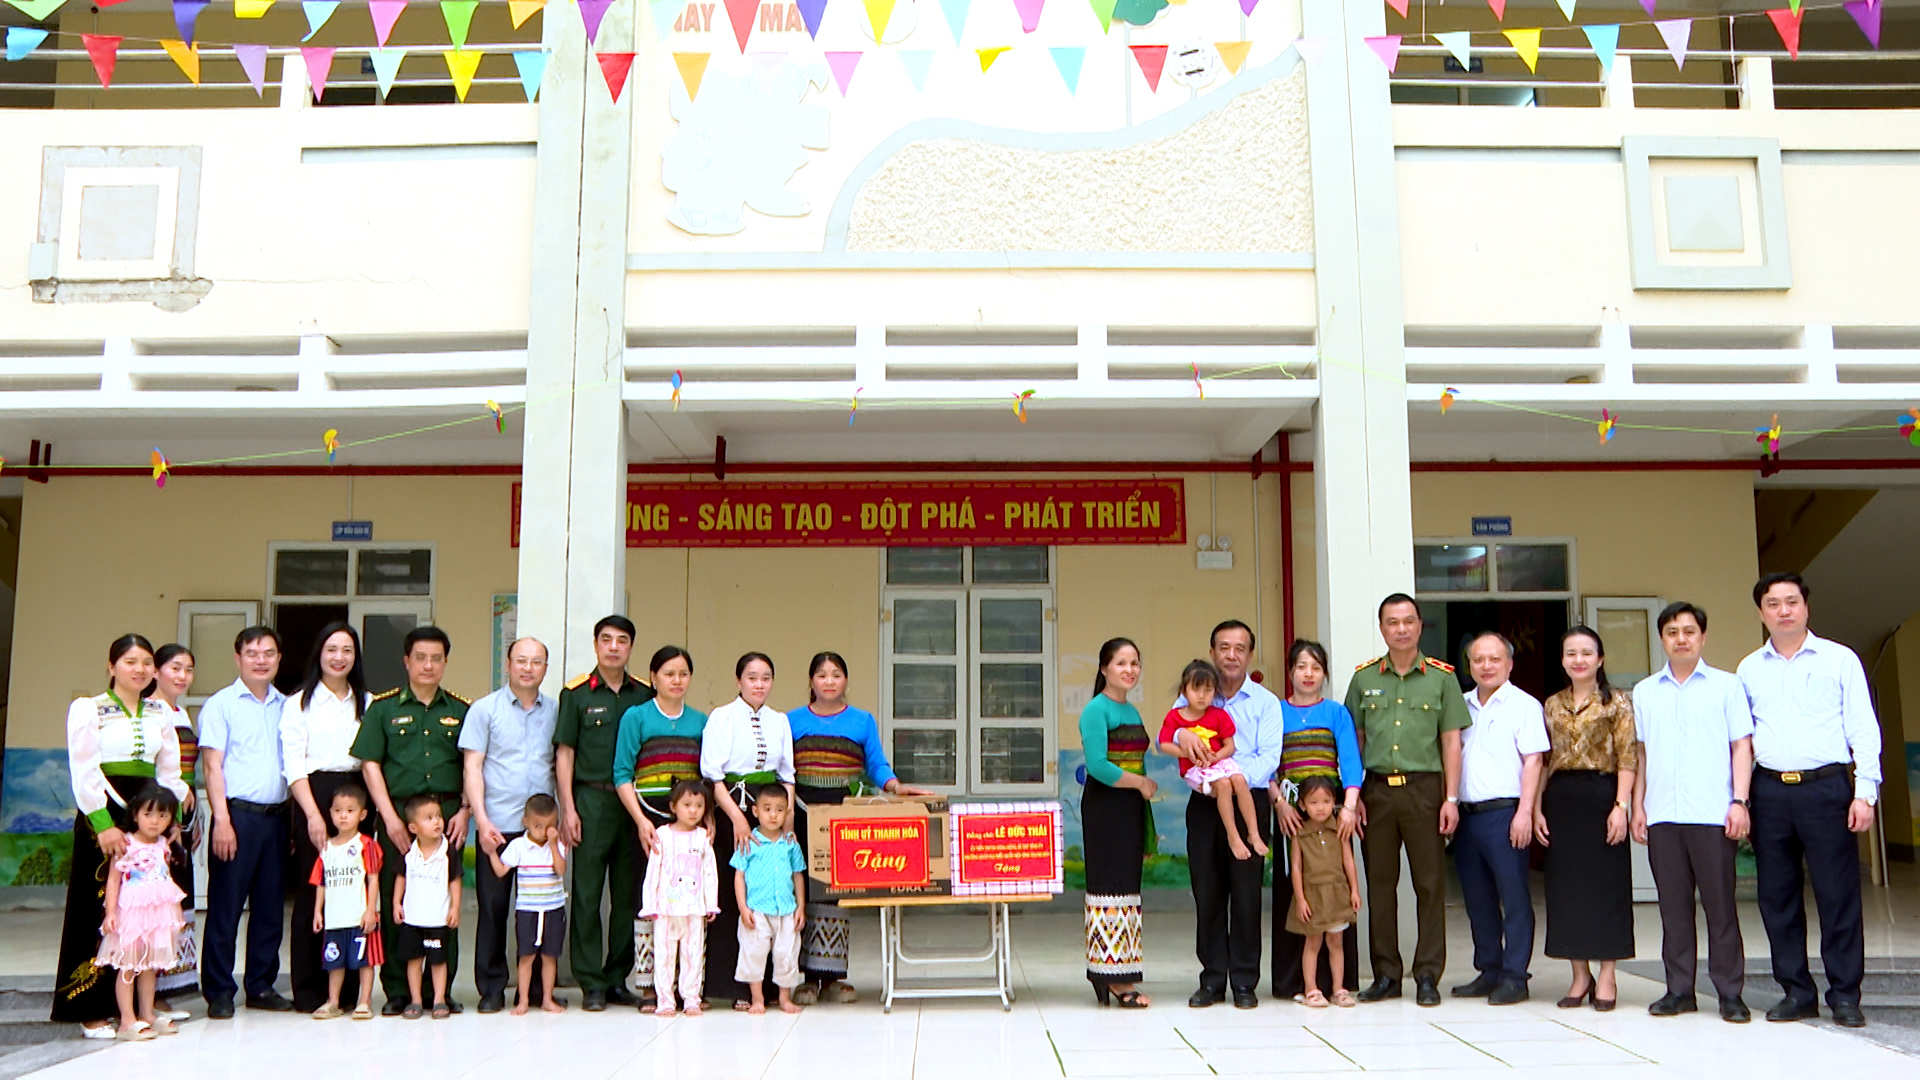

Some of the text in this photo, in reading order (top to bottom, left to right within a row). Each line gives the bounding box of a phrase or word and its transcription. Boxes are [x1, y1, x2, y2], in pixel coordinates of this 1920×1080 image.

[760, 3, 809, 32] MA
[698, 497, 772, 531] SÁNG
[781, 503, 833, 536] TẠO
[860, 497, 912, 536] ĐỘT
[921, 496, 976, 529] PHÁ
[1004, 496, 1074, 529] PHÁT
[1082, 490, 1161, 528] TRIỂN
[874, 827, 900, 839] THANH
[902, 826, 919, 838] HÓA
[995, 825, 1006, 838] LÊ
[1008, 824, 1025, 837] ĐỨC
[1027, 824, 1047, 836] THÁI
[853, 849, 907, 872] Tặng
[993, 863, 1021, 873] Tặng
[354, 937, 366, 960] 7
